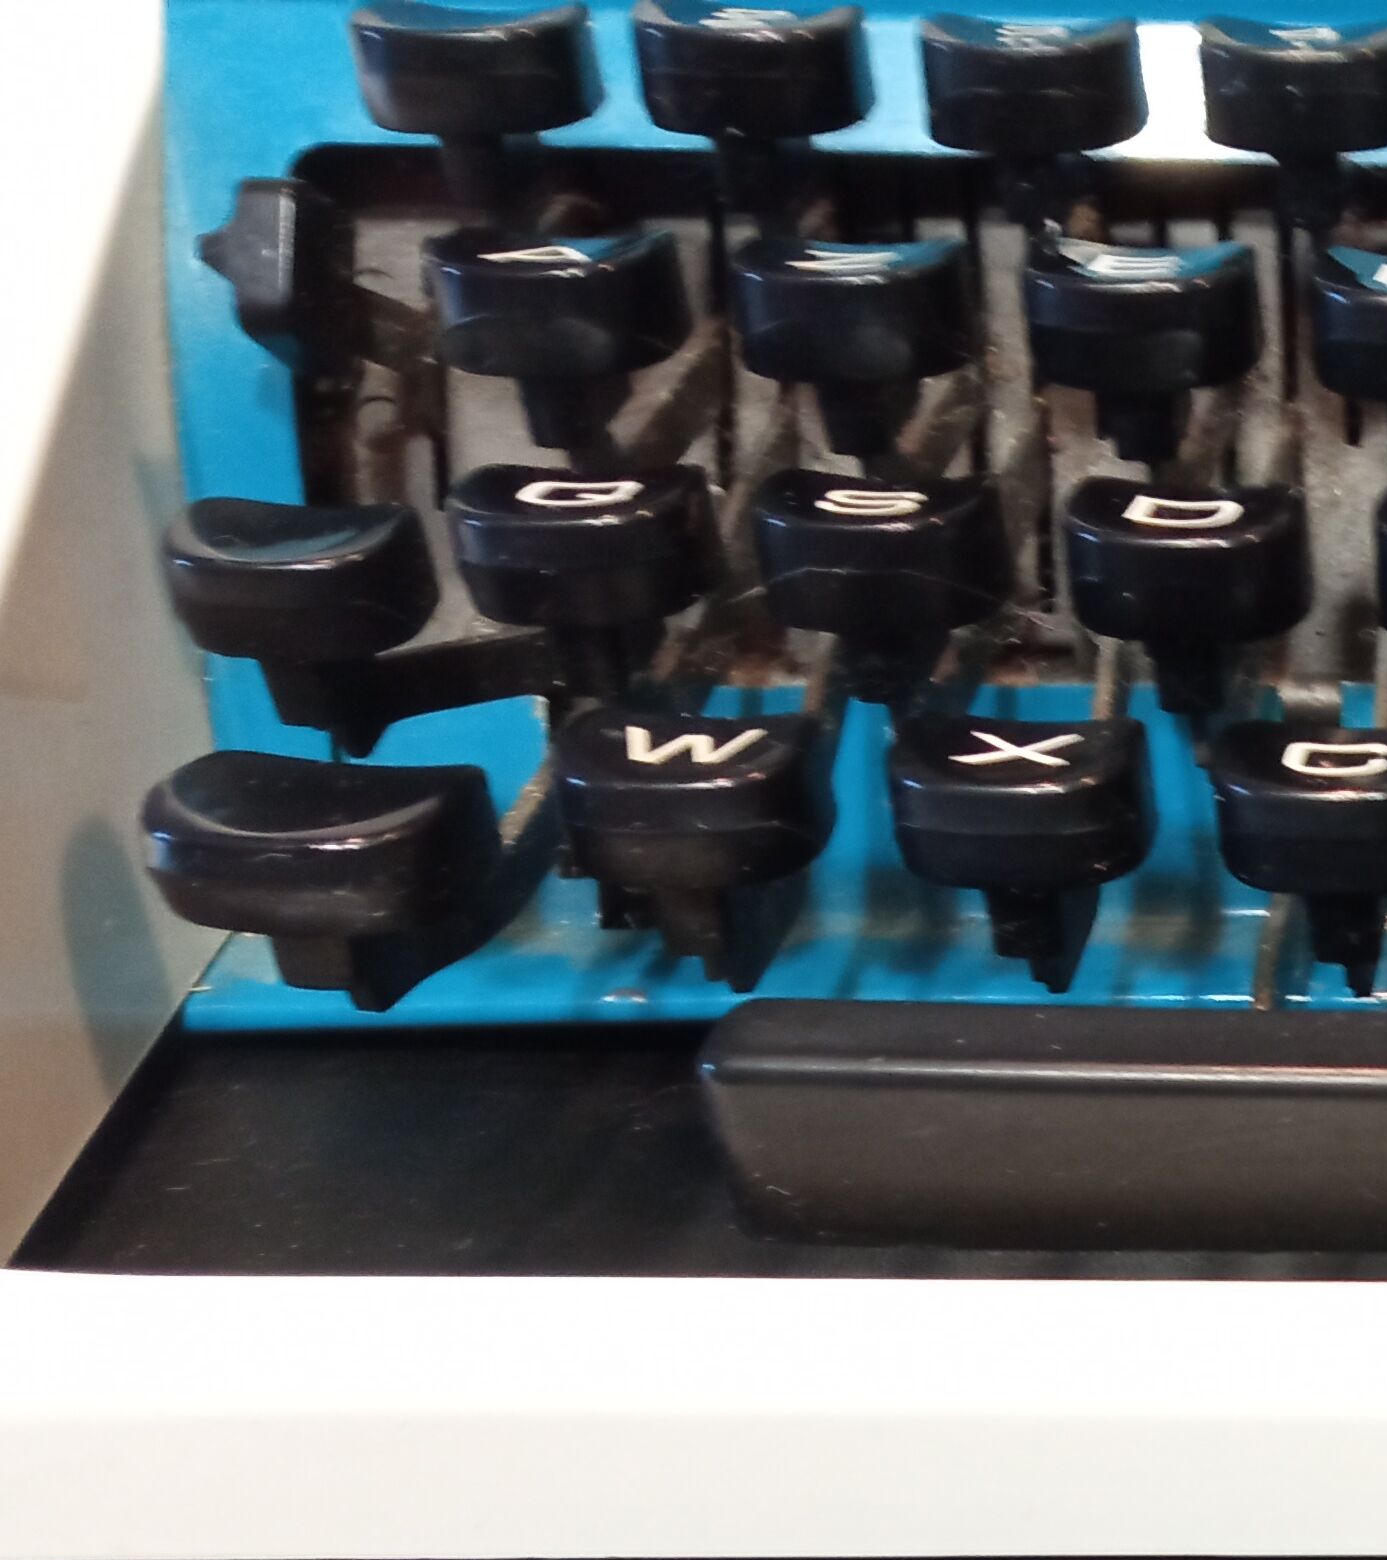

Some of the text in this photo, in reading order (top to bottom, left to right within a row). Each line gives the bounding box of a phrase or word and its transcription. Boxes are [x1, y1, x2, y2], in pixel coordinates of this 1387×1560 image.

[814, 490, 928, 516] S
[1122, 496, 1245, 528] D
[625, 725, 769, 765] W
[948, 730, 1085, 767] X
